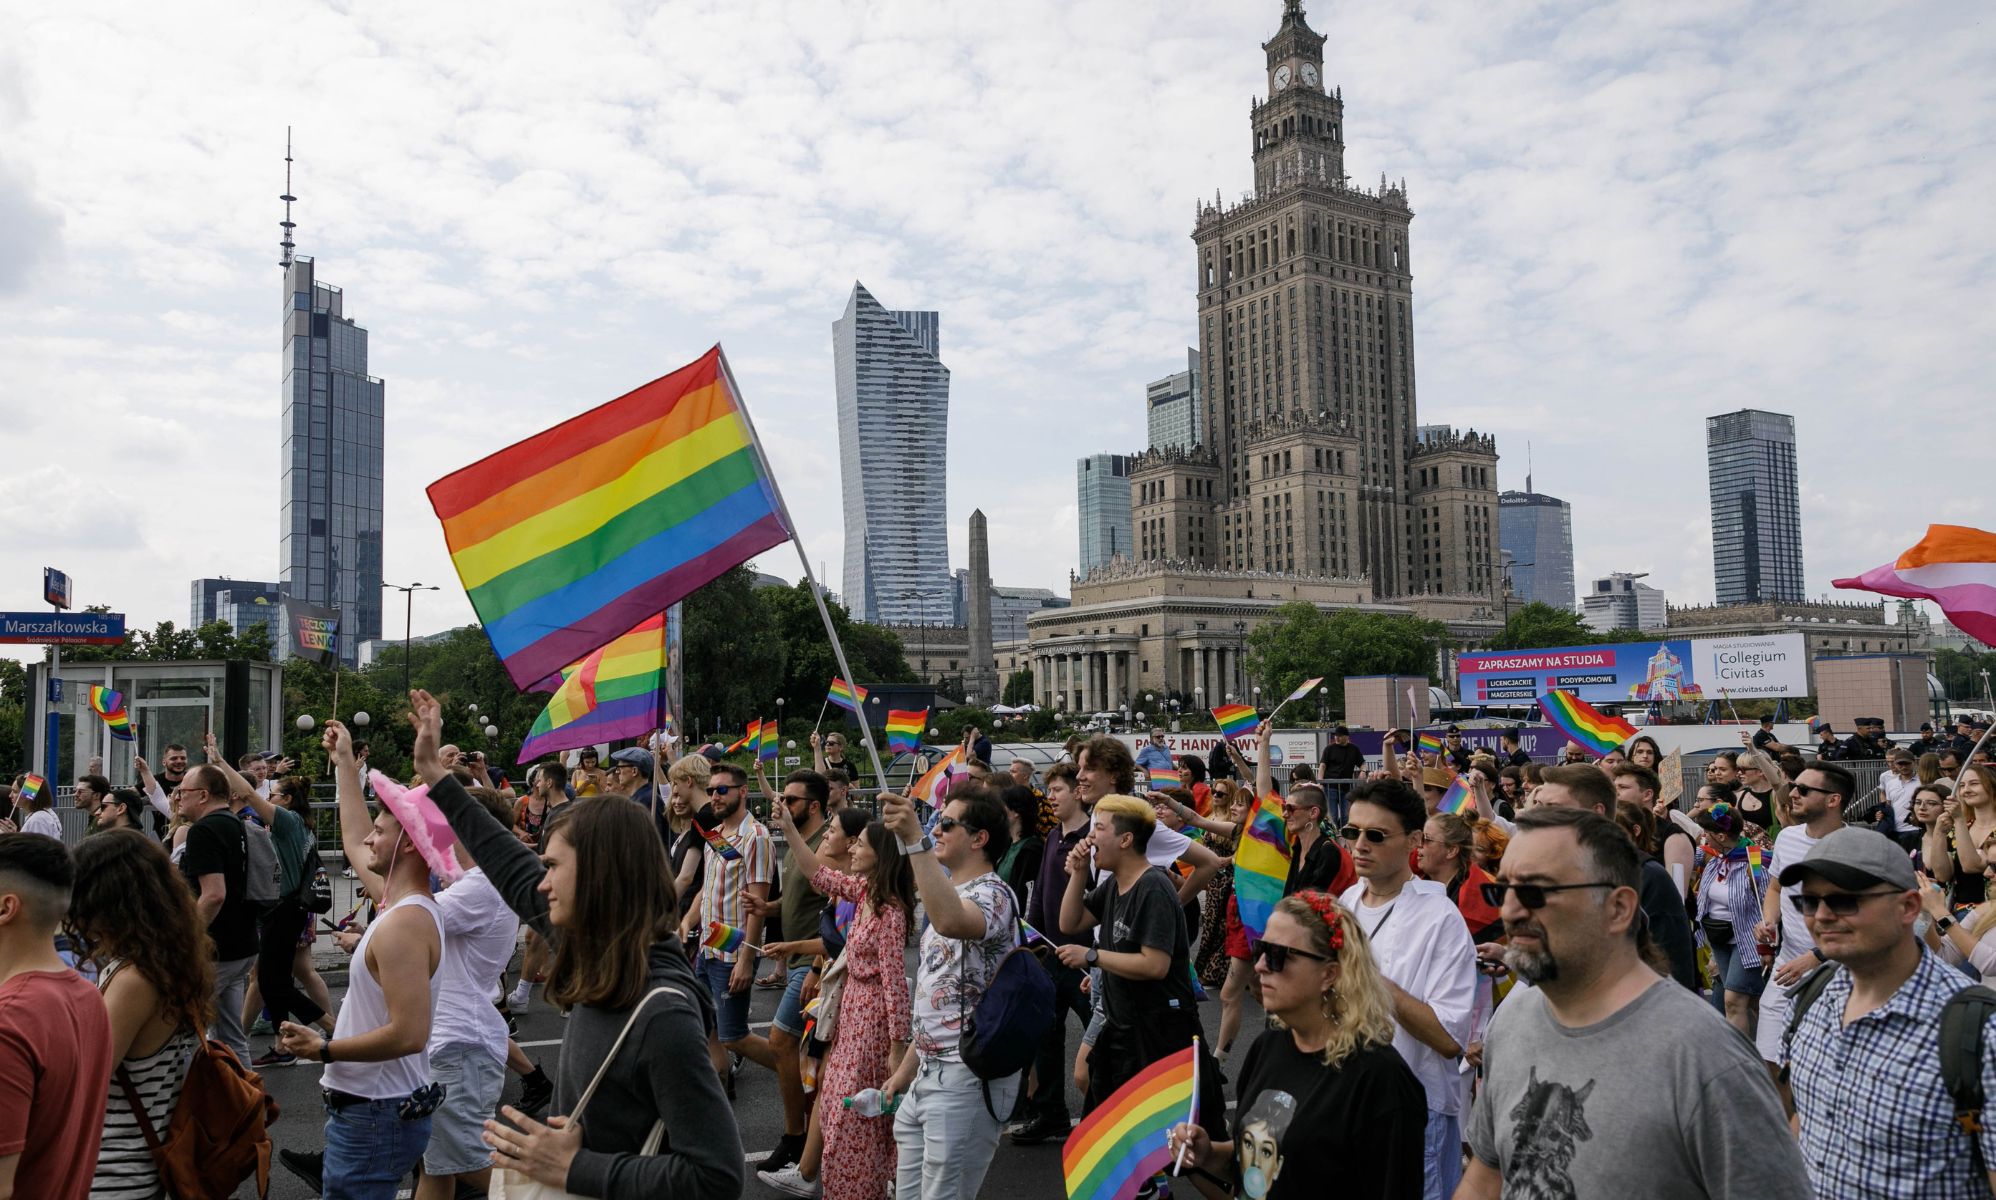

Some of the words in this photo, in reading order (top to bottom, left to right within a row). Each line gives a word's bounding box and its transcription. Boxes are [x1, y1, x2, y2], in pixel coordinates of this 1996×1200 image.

[5, 620, 108, 634] Marszałkowska
[26, 635, 60, 643] Śródmieście
[1478, 657, 1543, 670] ZAPRASZAMY
[1546, 657, 1561, 667] NA
[1563, 654, 1604, 666] STUDIA
[1720, 651, 1786, 666] Collegium
[1721, 668, 1765, 680] Civitas
[1490, 679, 1533, 687] LICENCJACKIE
[1560, 675, 1613, 684] PODYPLOMOWE
[1716, 684, 1788, 693] www.civitas.edu.pl
[1490, 690, 1533, 698] MAGISTERSKIE
[1135, 736, 1176, 750] PAŻ
[1181, 738, 1260, 751] HANDOWY
